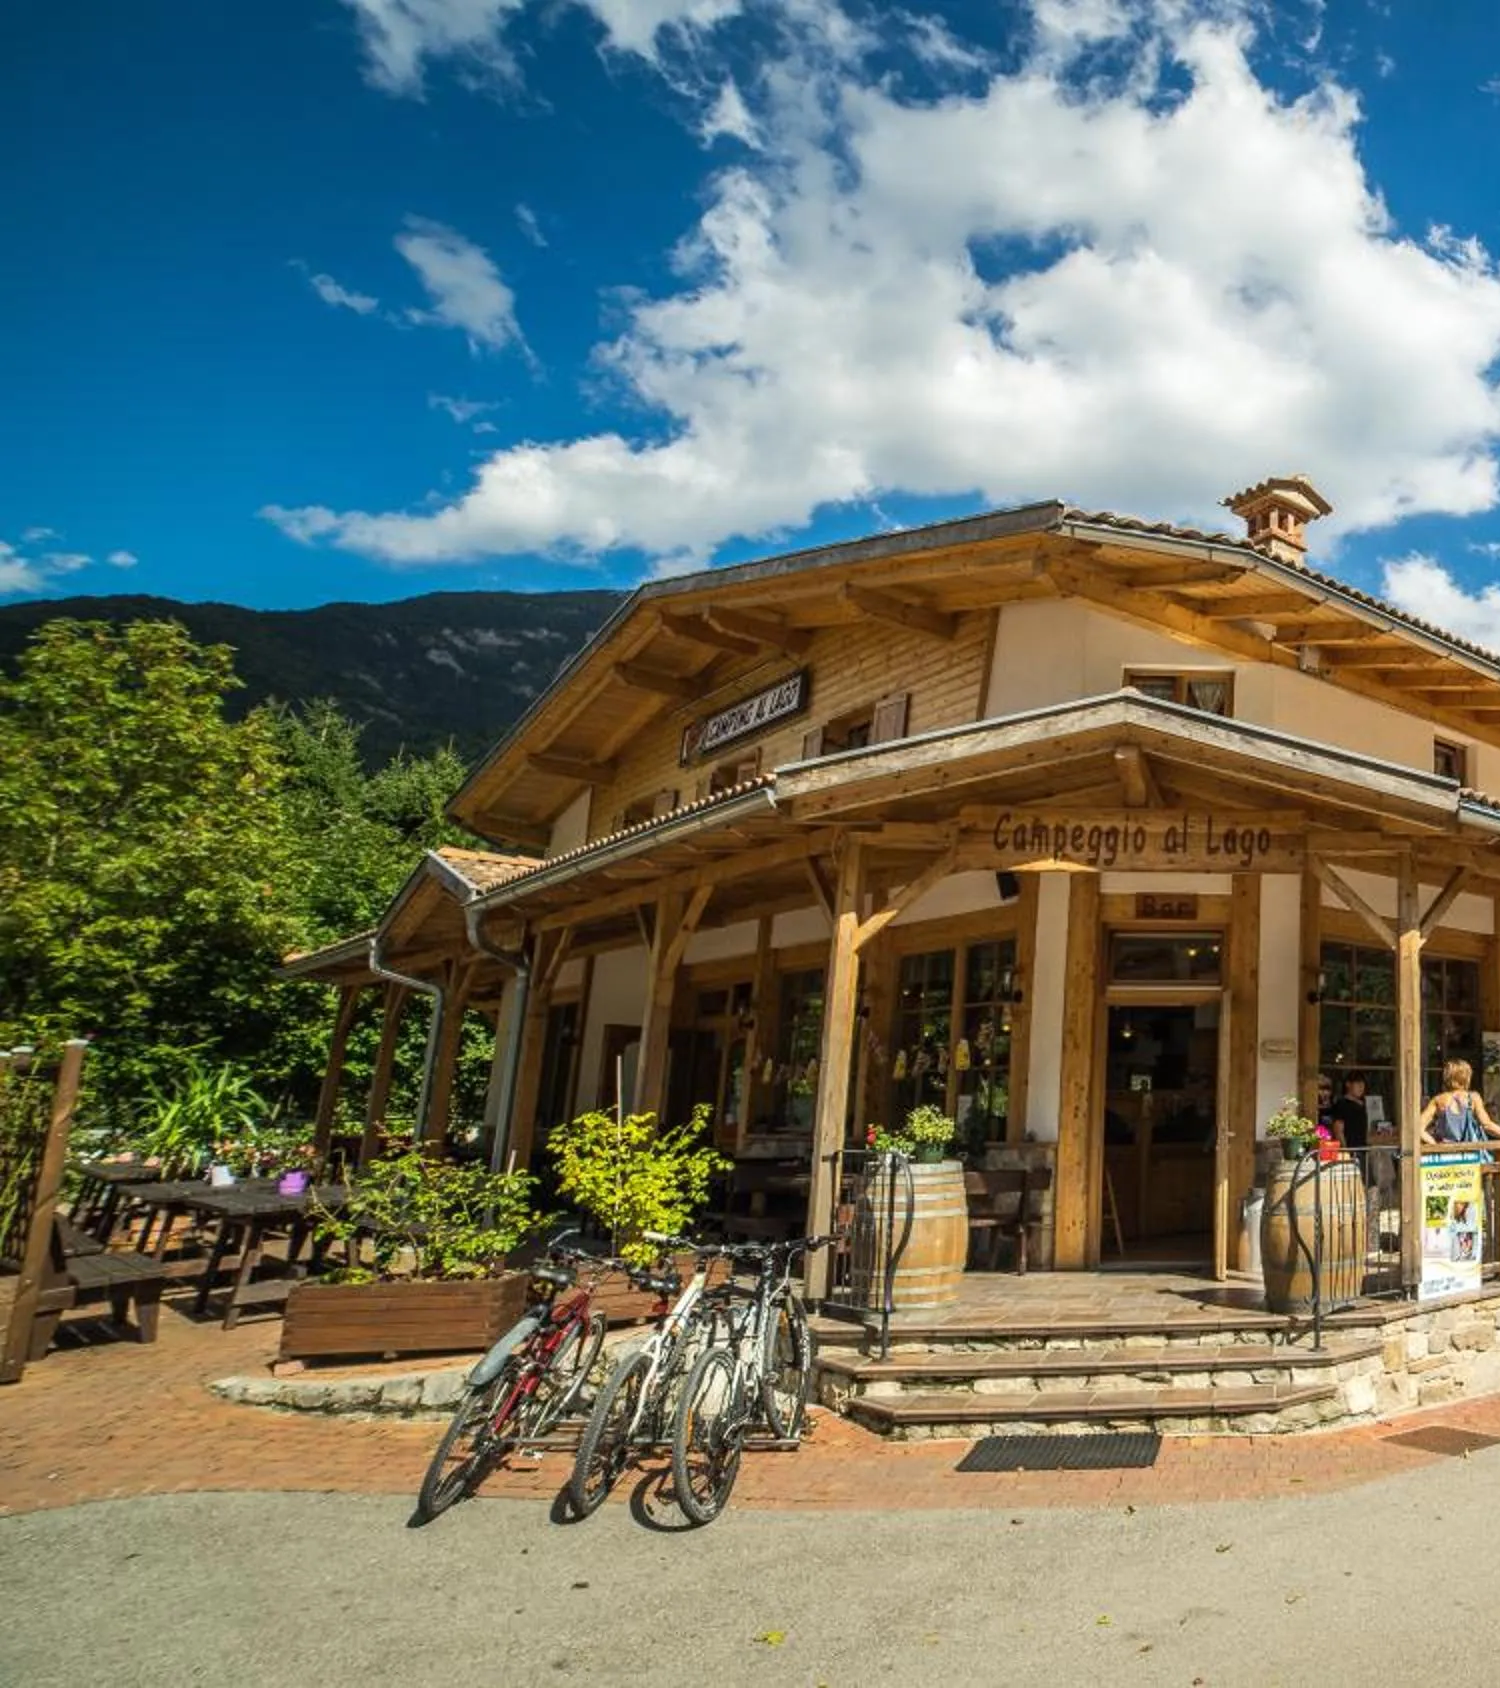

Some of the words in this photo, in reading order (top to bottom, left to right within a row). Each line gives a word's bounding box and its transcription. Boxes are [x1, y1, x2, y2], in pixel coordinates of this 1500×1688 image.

[993, 812, 1147, 866] Campeggio
[1163, 814, 1188, 854] al
[1206, 815, 1271, 867] Lago
[1142, 895, 1191, 919] Bar
